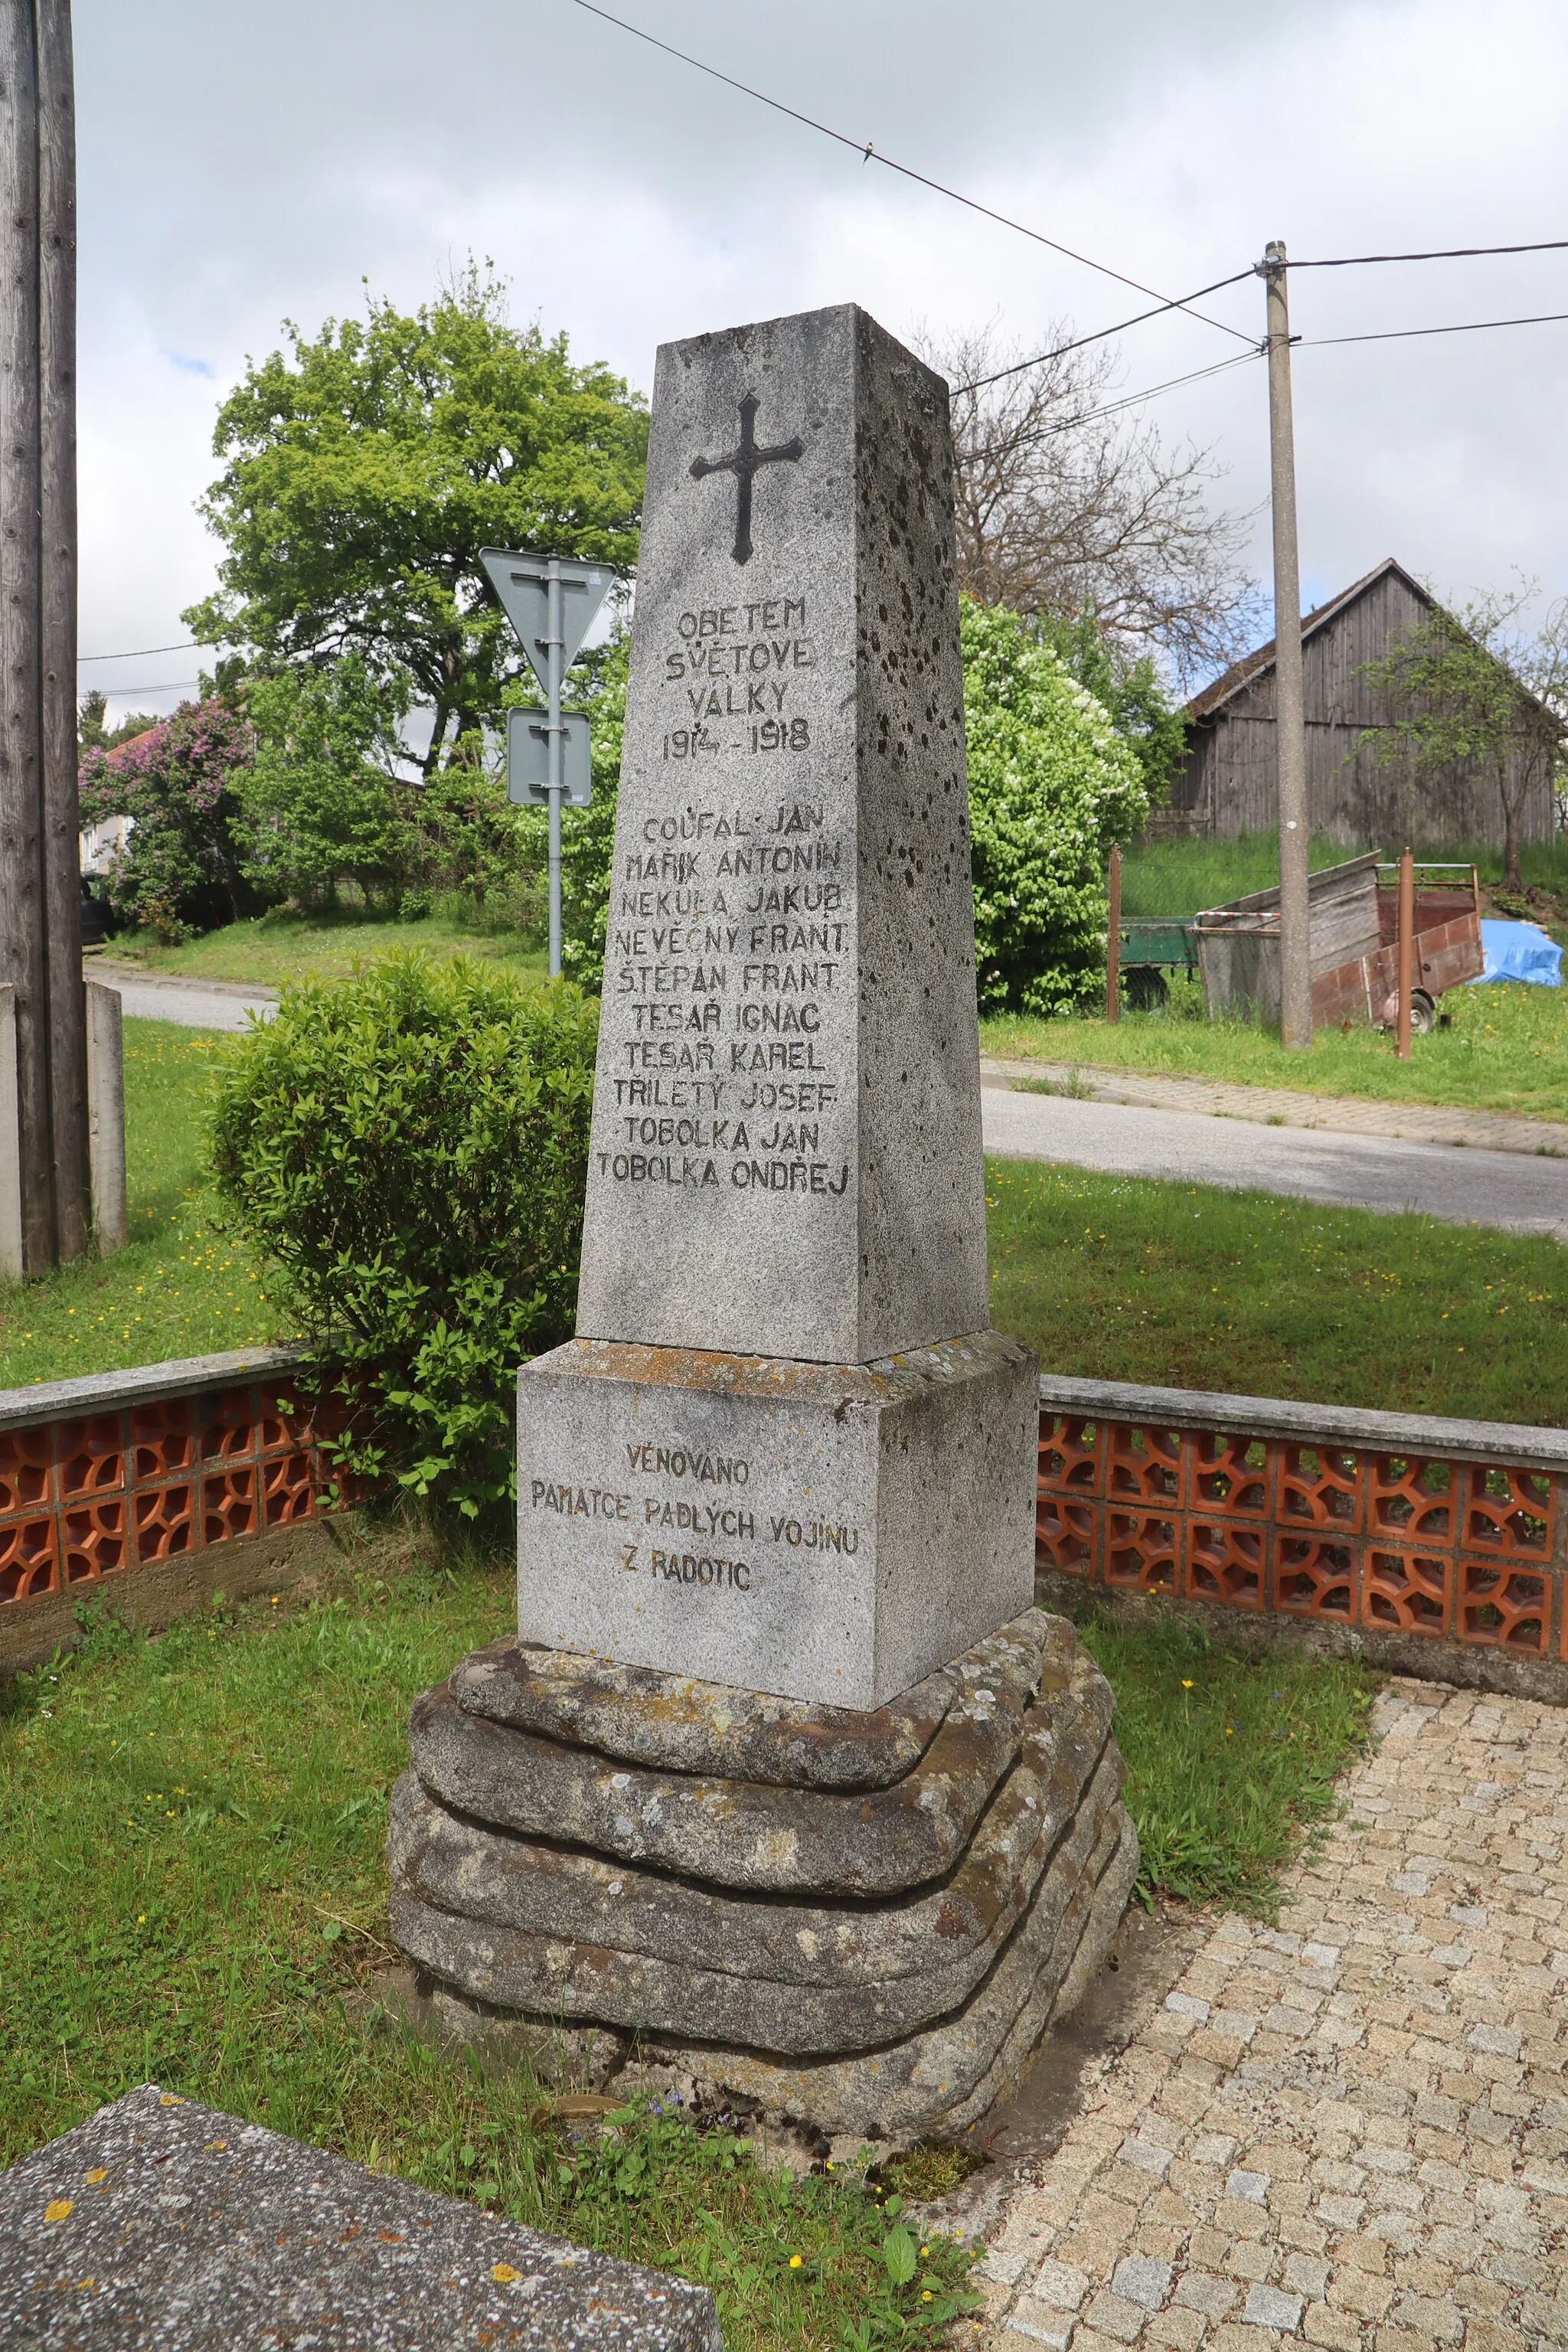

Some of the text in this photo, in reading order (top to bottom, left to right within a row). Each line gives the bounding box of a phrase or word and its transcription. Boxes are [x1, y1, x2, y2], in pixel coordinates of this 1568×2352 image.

[663, 725, 720, 760] 1914
[750, 718, 811, 754] 1918
[643, 805, 825, 843] COUFAL JAN
[622, 883, 842, 917] NEKULA JAKUB
[632, 998, 722, 1033] TESAŘ
[623, 1037, 826, 1073] TESAŘ KAREL
[623, 1117, 819, 1154] TOBOLKA JAN
[597, 1153, 849, 1196] TOBOLKA ONDŘEJ
[645, 1498, 755, 1540] PADLÝCH
[623, 1544, 751, 1591] Z RADOTIC
